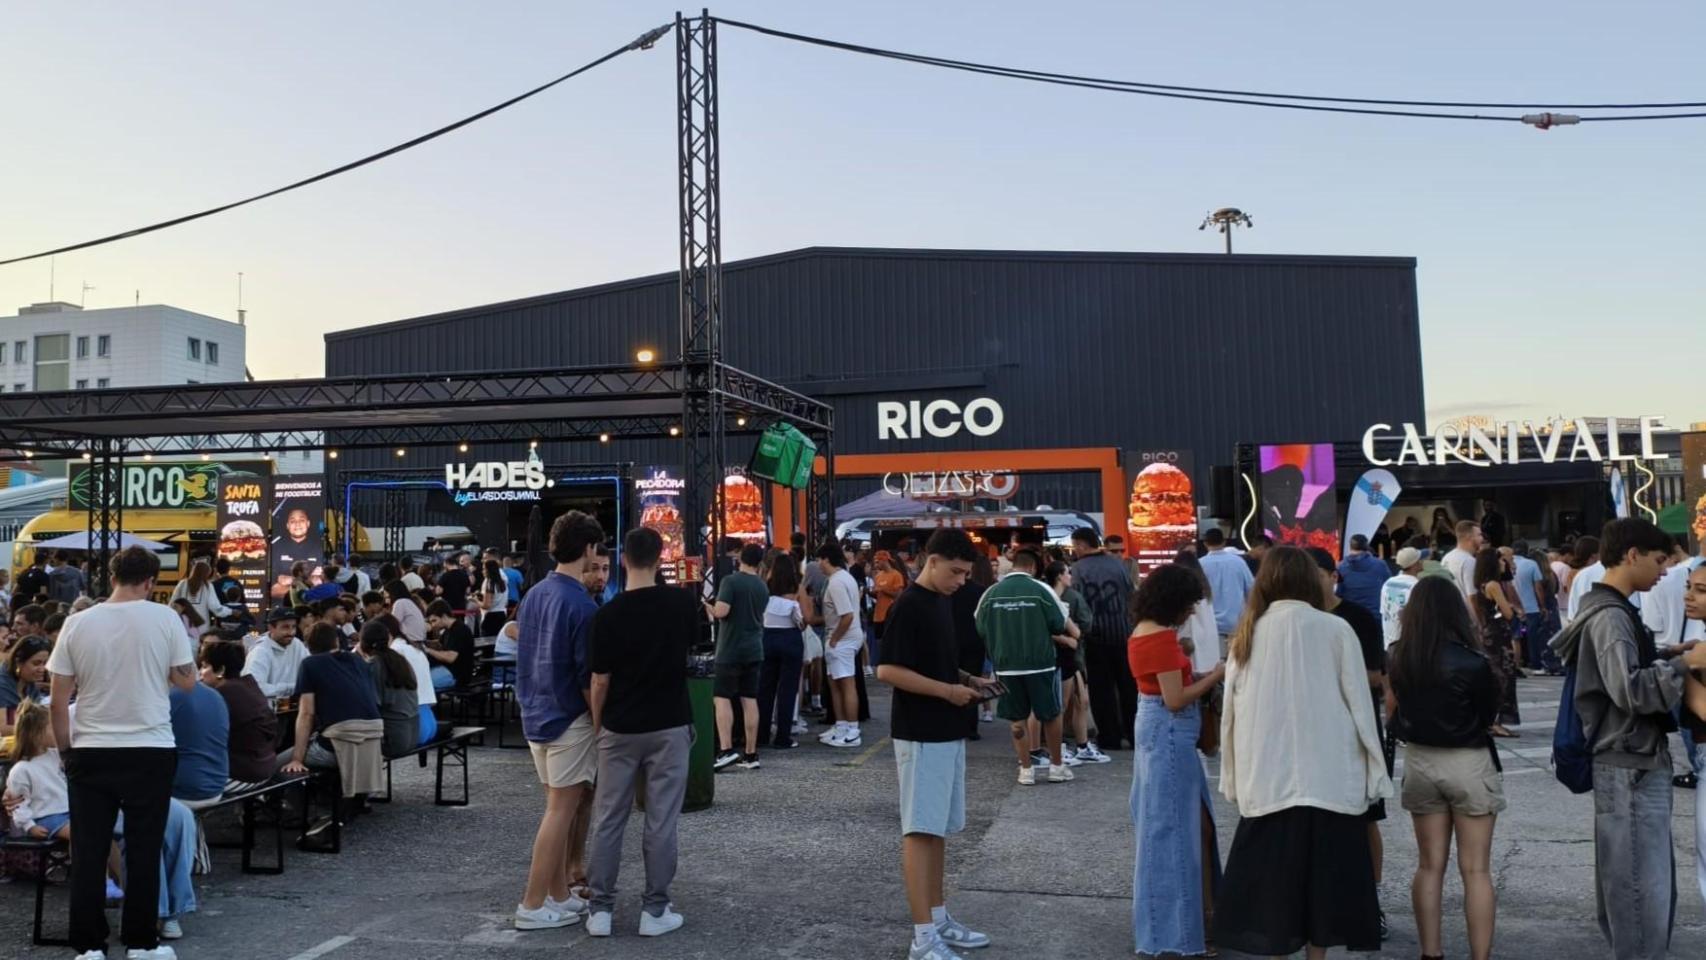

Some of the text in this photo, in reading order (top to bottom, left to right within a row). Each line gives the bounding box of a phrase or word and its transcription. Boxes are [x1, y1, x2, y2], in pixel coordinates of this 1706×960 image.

[878, 397, 1004, 440] RICO
[1362, 415, 1671, 467] CARNIVALE
[1142, 451, 1179, 463] RICO
[654, 470, 667, 480] LA
[635, 479, 685, 489] PECADORA
[225, 485, 261, 499] SANTA
[226, 500, 260, 516] TRUFA
